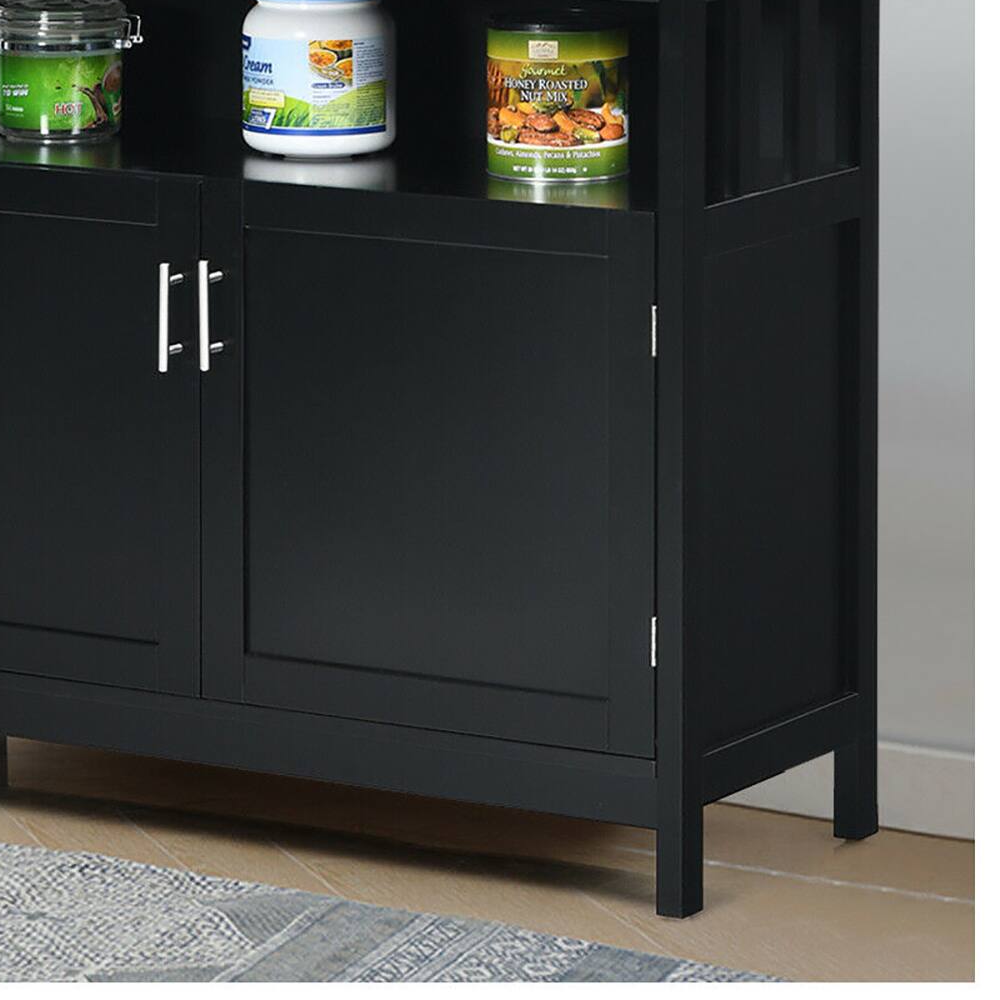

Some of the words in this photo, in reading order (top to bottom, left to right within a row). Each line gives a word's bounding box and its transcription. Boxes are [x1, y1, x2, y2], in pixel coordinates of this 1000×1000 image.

[505, 78, 537, 90] HONEY
[539, 79, 588, 90] ROASTED
[521, 91, 542, 102] NUT
[547, 92, 568, 102] MIX
[55, 103, 82, 115] HOT
